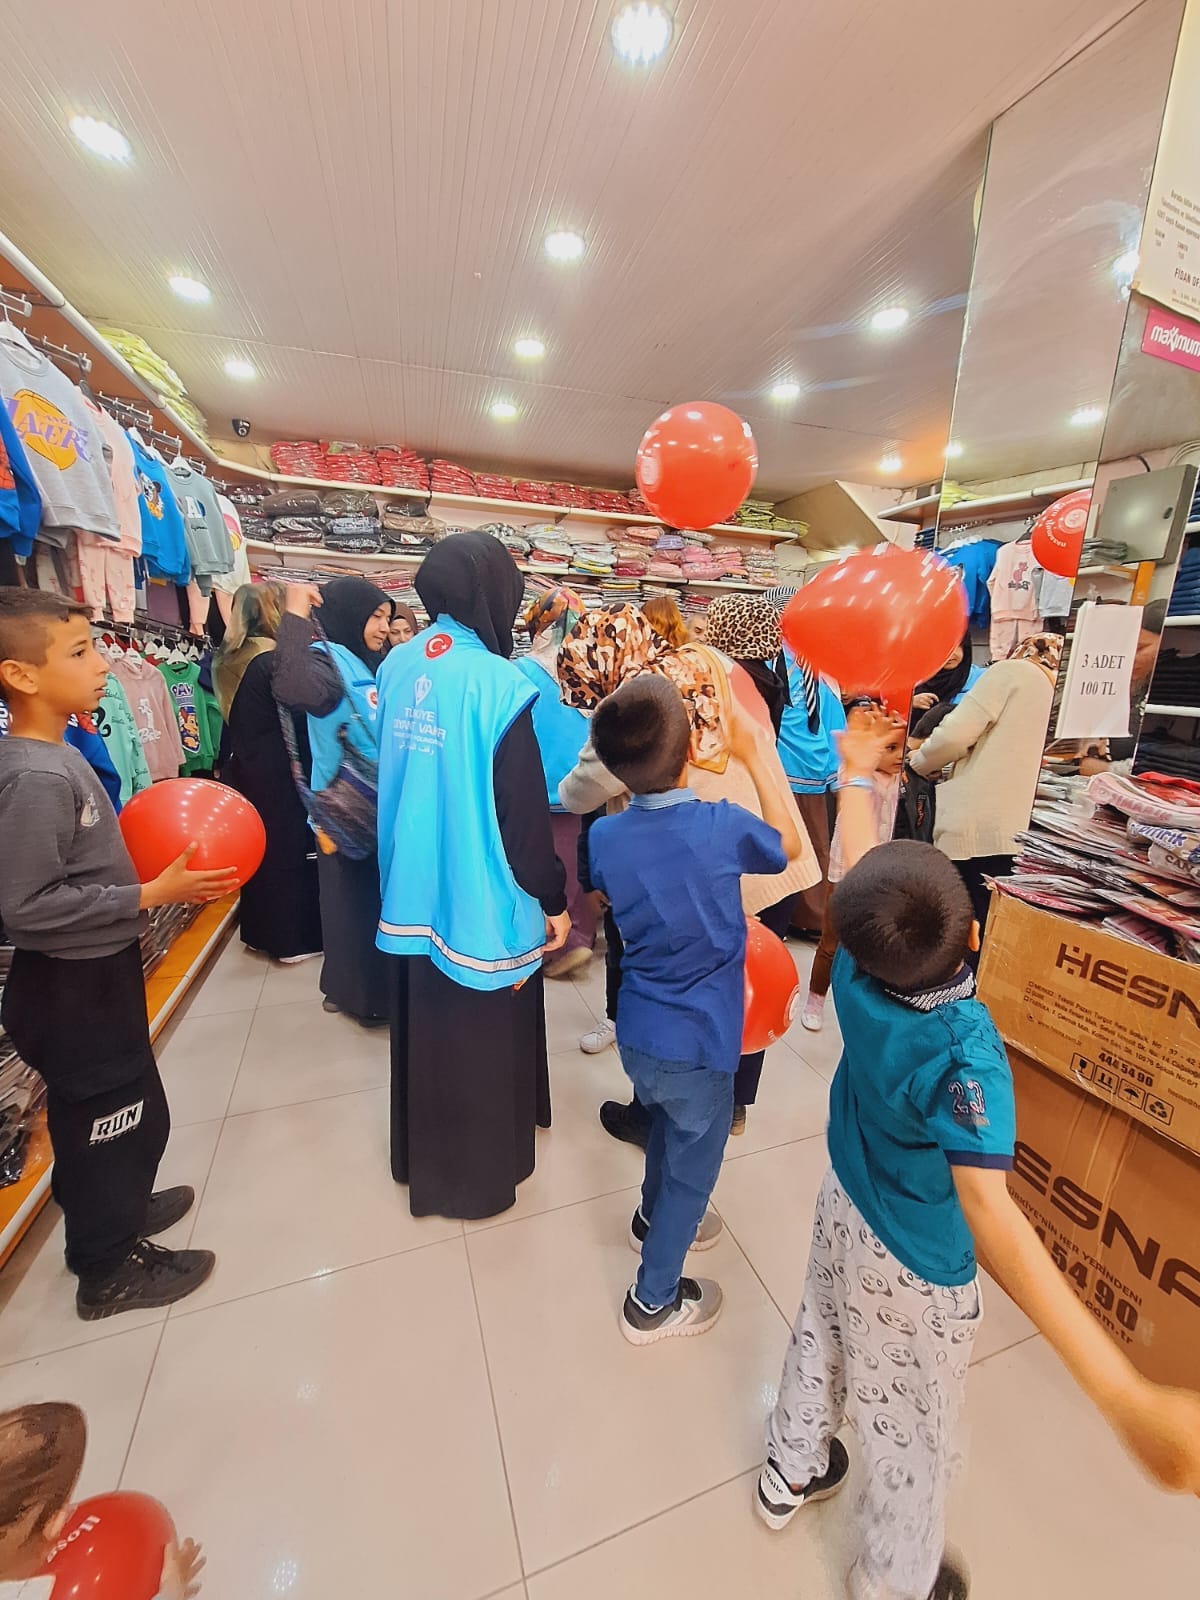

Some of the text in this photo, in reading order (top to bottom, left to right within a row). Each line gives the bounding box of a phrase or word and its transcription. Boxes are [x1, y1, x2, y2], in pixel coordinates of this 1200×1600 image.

[1081, 654, 1126, 669] 3 ADET
[1080, 681, 1117, 696] 100 TL
[1120, 1063, 1136, 1078] 54
[97, 1106, 138, 1136] RUN
[1013, 1141, 1200, 1310] ESNA
[1059, 1232, 1080, 1253] HER
[1094, 1279, 1139, 1332] 90
